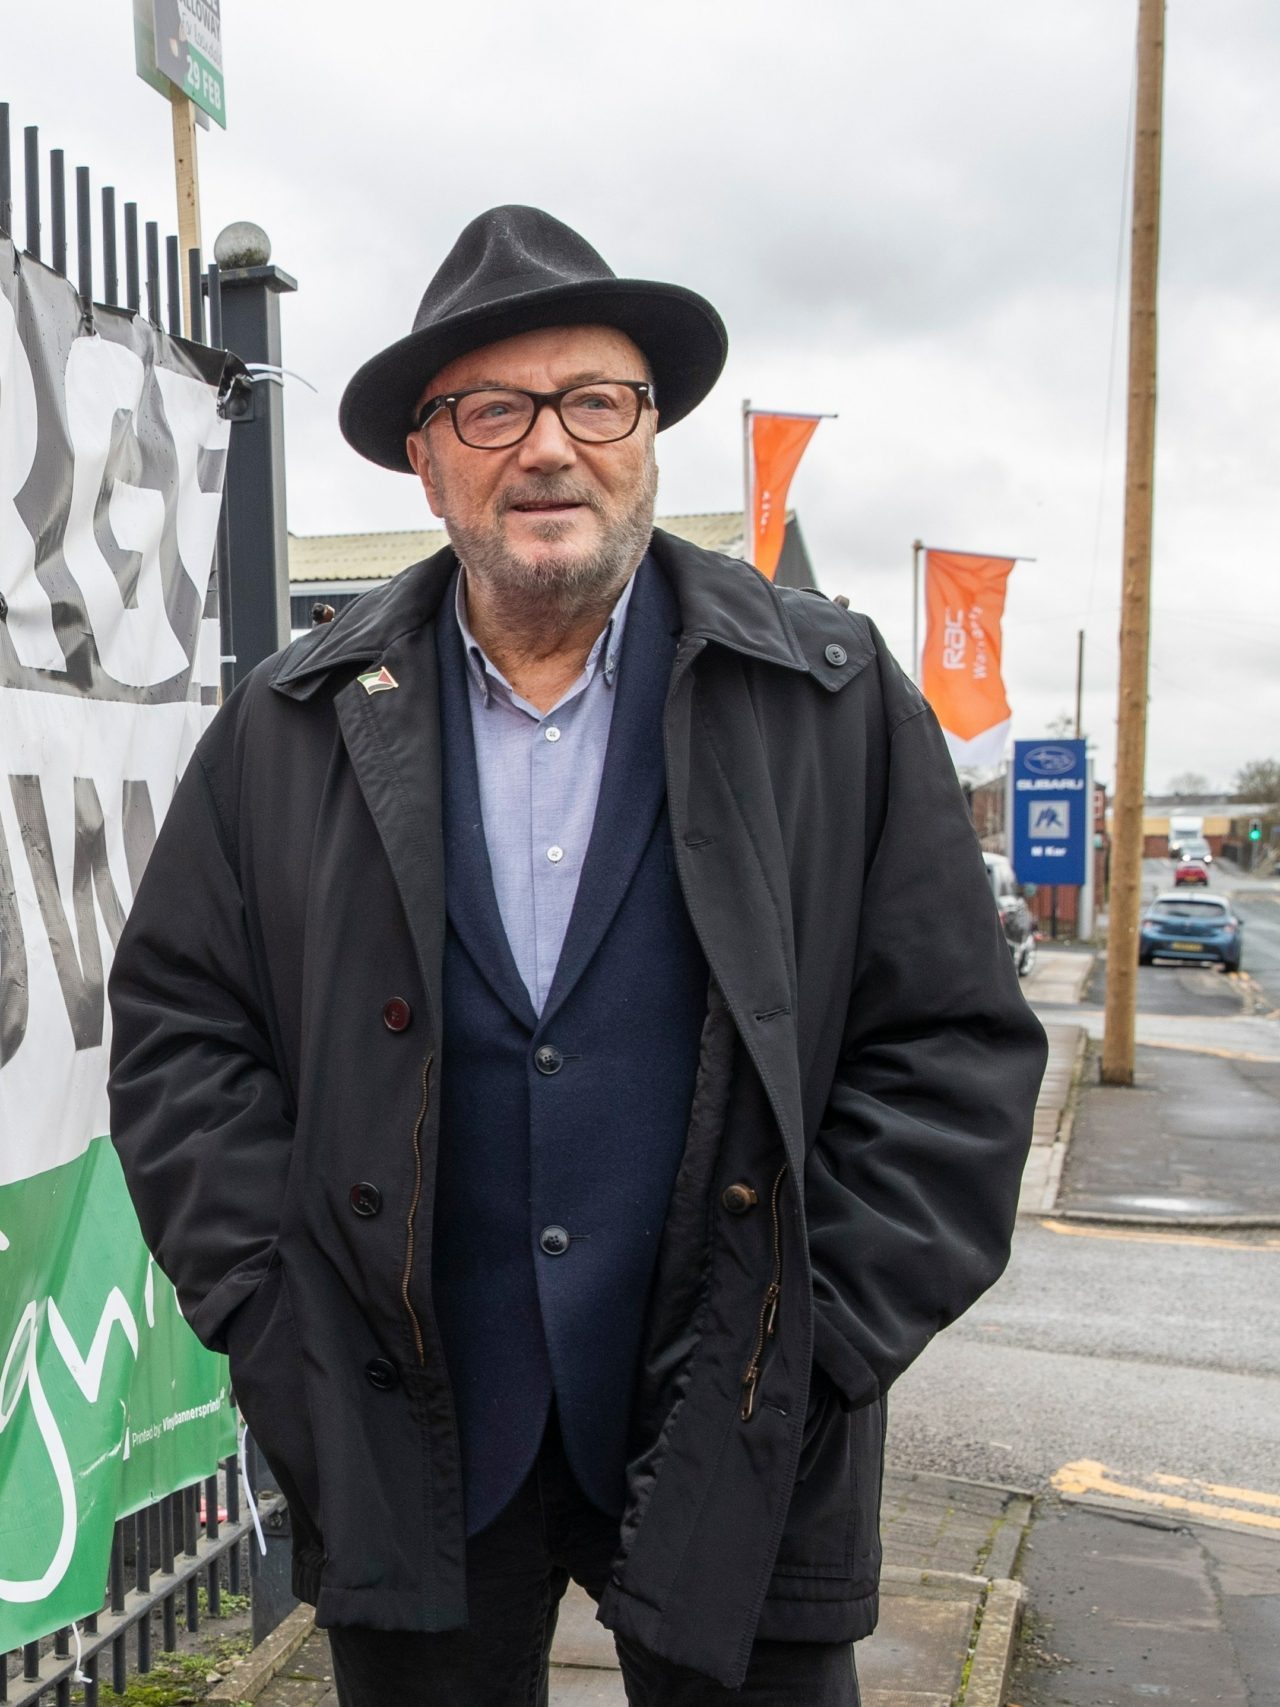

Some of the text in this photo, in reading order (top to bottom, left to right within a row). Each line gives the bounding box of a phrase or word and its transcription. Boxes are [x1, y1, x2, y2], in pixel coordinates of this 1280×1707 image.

[187, 54, 222, 111] 29 FEB
[1016, 778, 1085, 791] SUBARU
[131, 1423, 154, 1448] Printed
